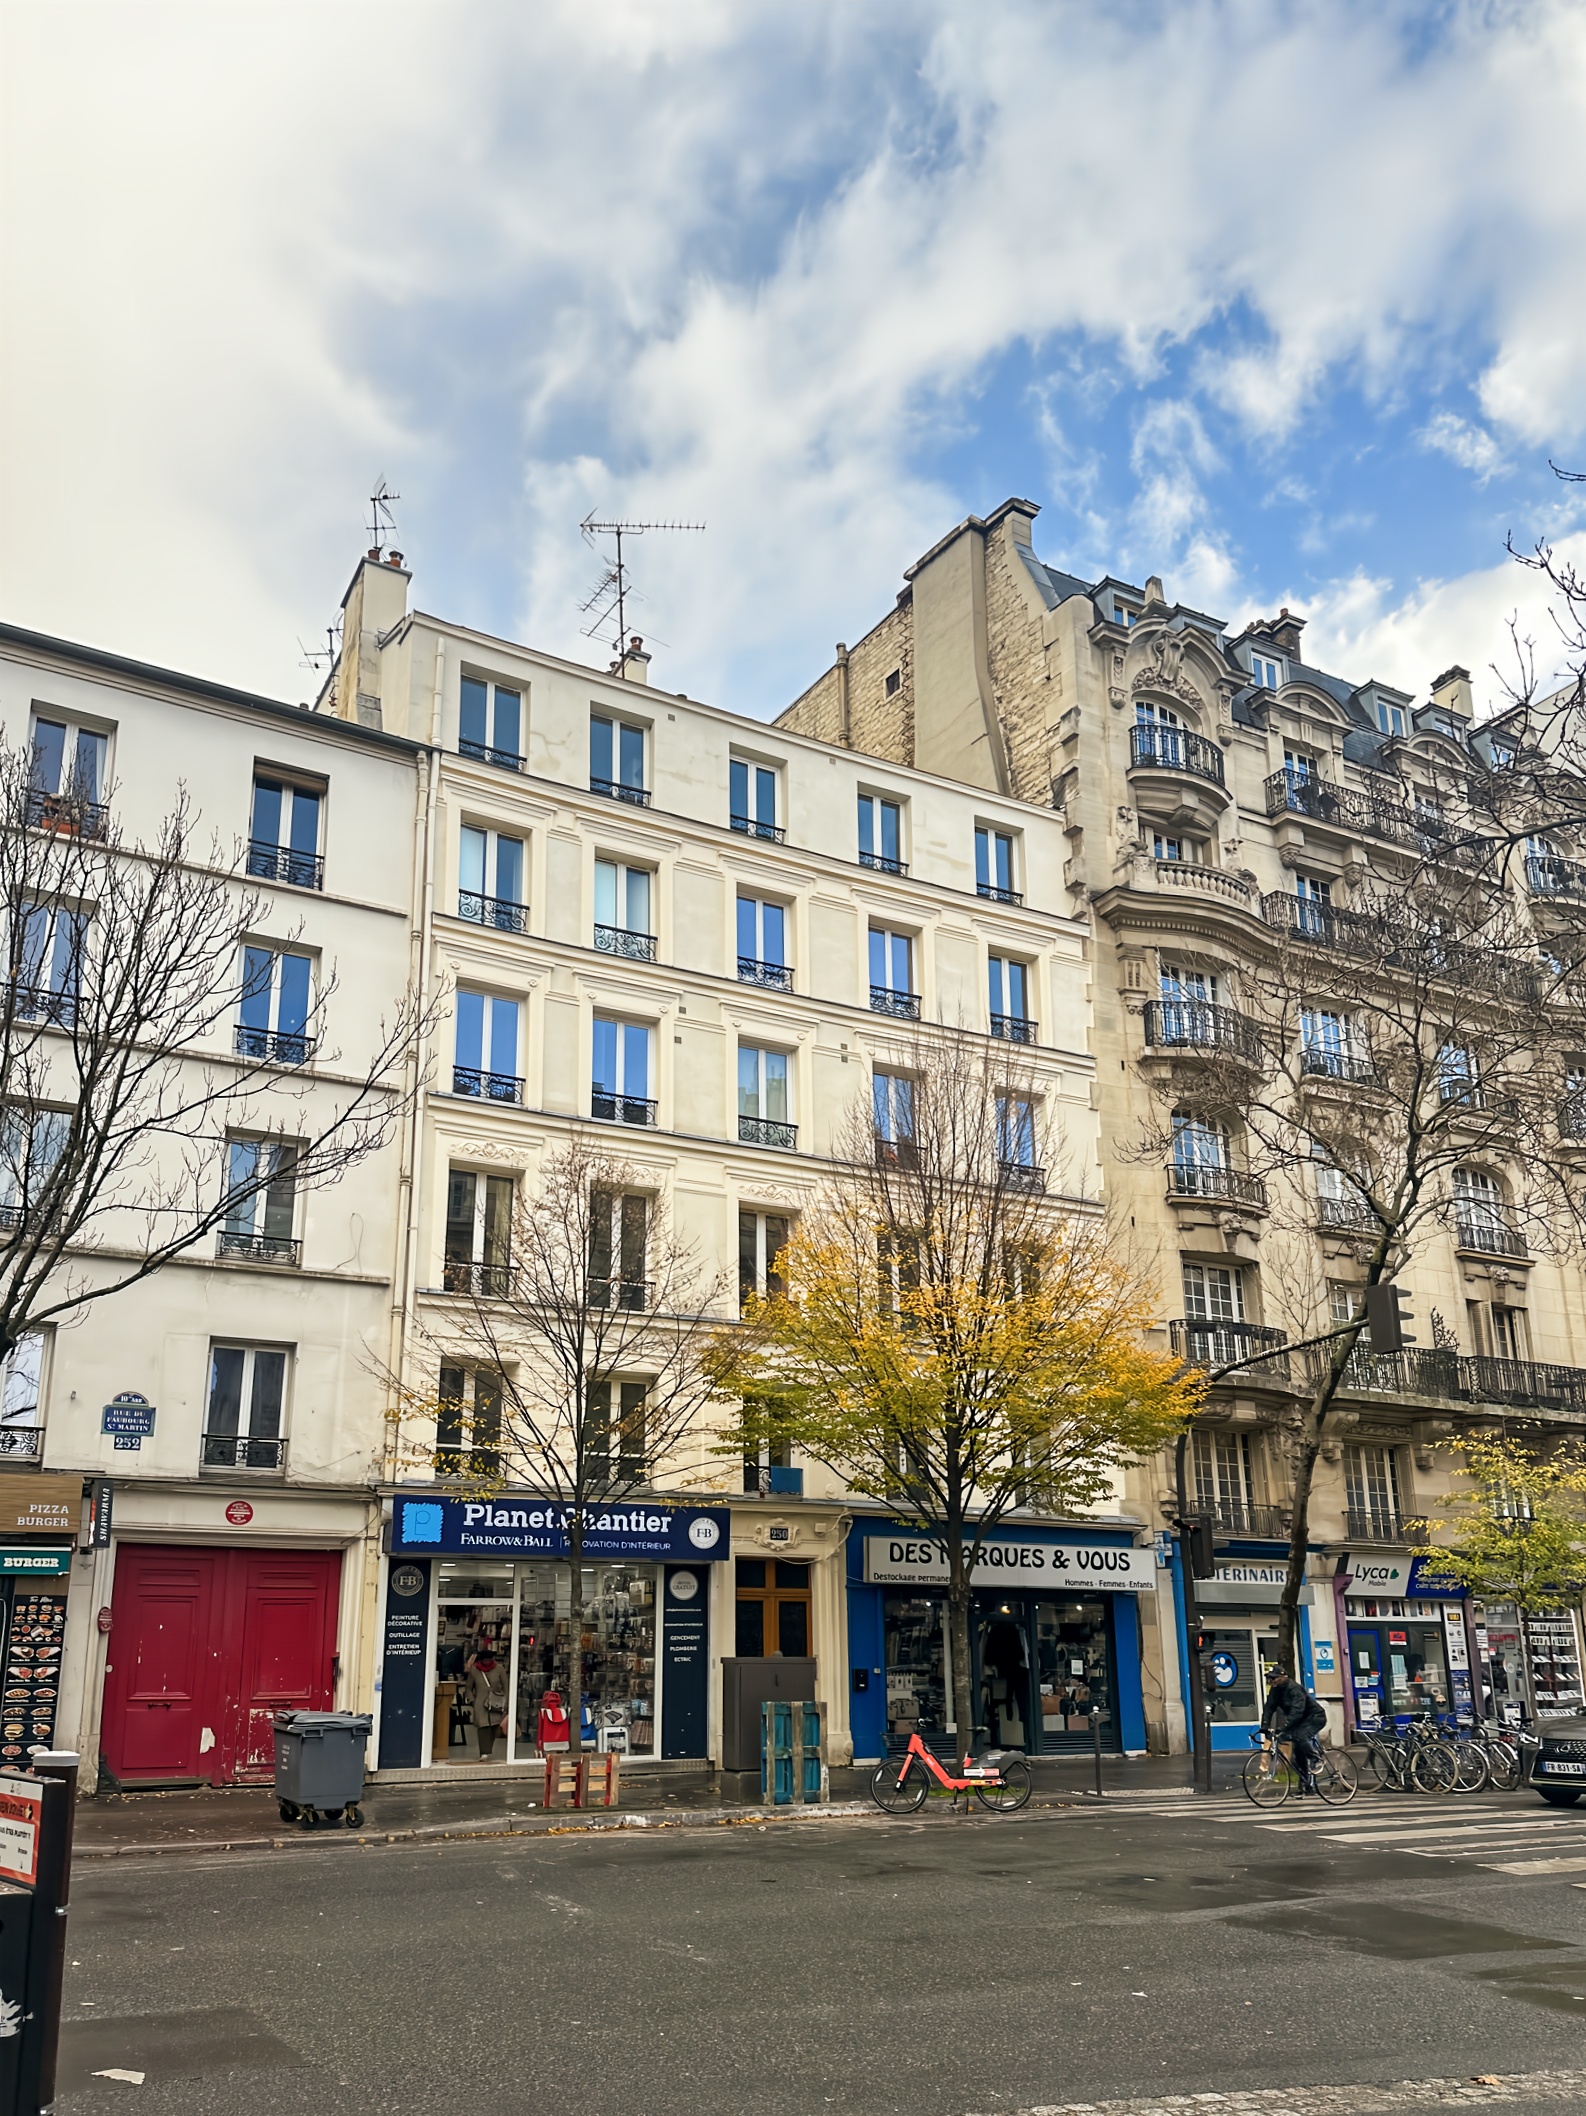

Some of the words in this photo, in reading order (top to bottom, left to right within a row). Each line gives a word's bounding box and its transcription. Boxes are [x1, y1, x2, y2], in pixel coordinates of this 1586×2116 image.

[107, 1417, 150, 1425] FAUBOURG
[115, 1437, 140, 1449] 252
[29, 1504, 69, 1514] PIZZA
[99, 1487, 110, 1541] SHAWARMA
[463, 1503, 554, 1529] Planet
[16, 1516, 69, 1527] BURGER
[771, 1529, 788, 1539] 250
[564, 1540, 619, 1549] ROVATION
[889, 1542, 933, 1564] DES
[1052, 1550, 1070, 1569] &
[1077, 1550, 1131, 1571] VOUS
[3, 1557, 60, 1568] BURGER
[873, 1572, 916, 1582] Destockage
[1355, 1563, 1390, 1581] Lyca
[1064, 1579, 1094, 1588] Hommes
[1099, 1580, 1126, 1588] Femmes
[1129, 1581, 1154, 1589] Enfants
[1368, 1579, 1387, 1587] Mobile
